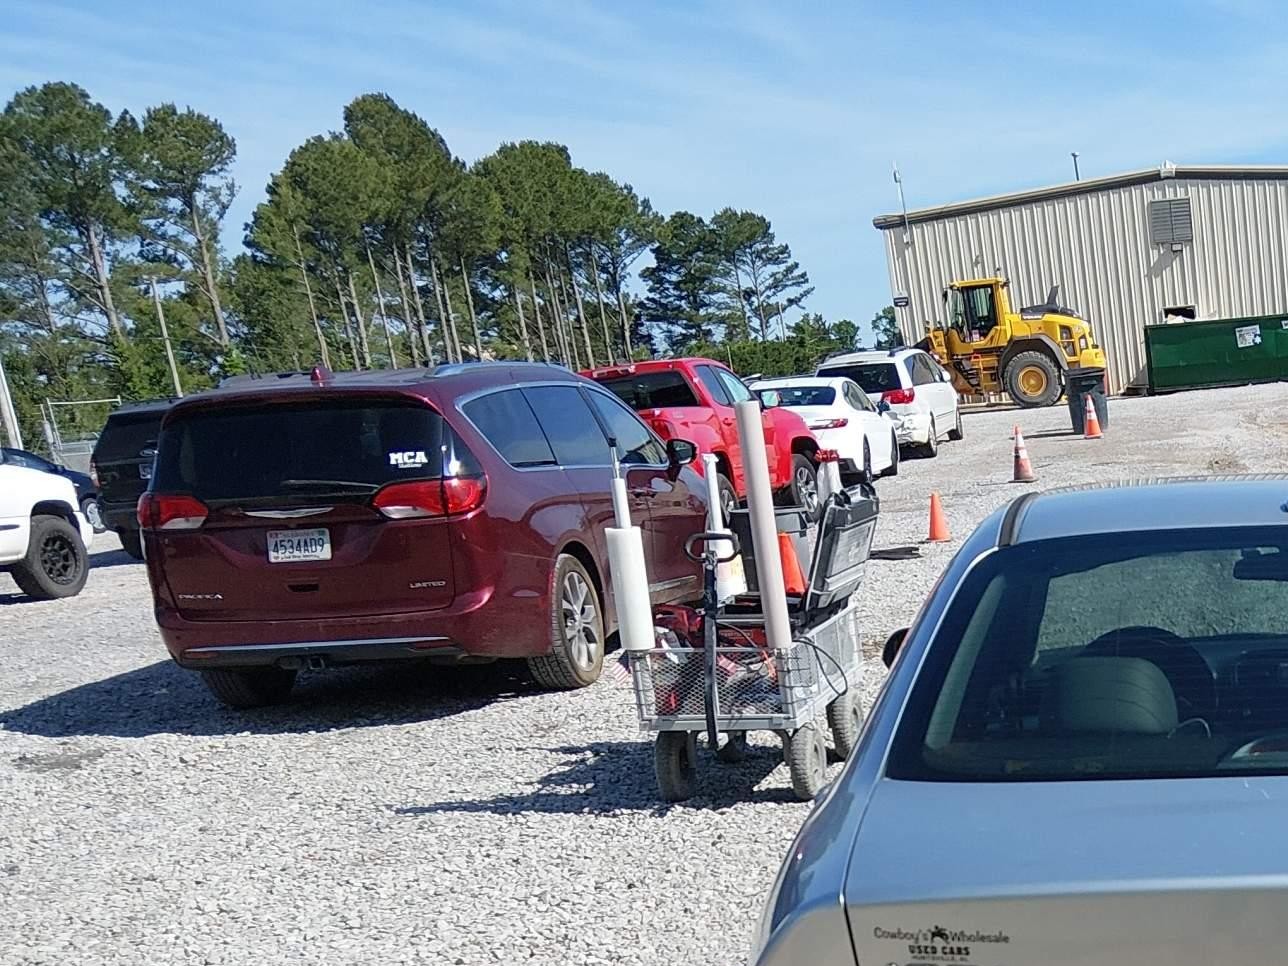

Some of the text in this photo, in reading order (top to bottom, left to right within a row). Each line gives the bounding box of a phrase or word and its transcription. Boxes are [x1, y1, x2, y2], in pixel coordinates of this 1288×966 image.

[389, 451, 429, 465] MCA
[272, 537, 325, 555] 4534AD9
[874, 926, 1010, 944] Cowboy's Wholesale
[908, 945, 971, 957] USED CARS
